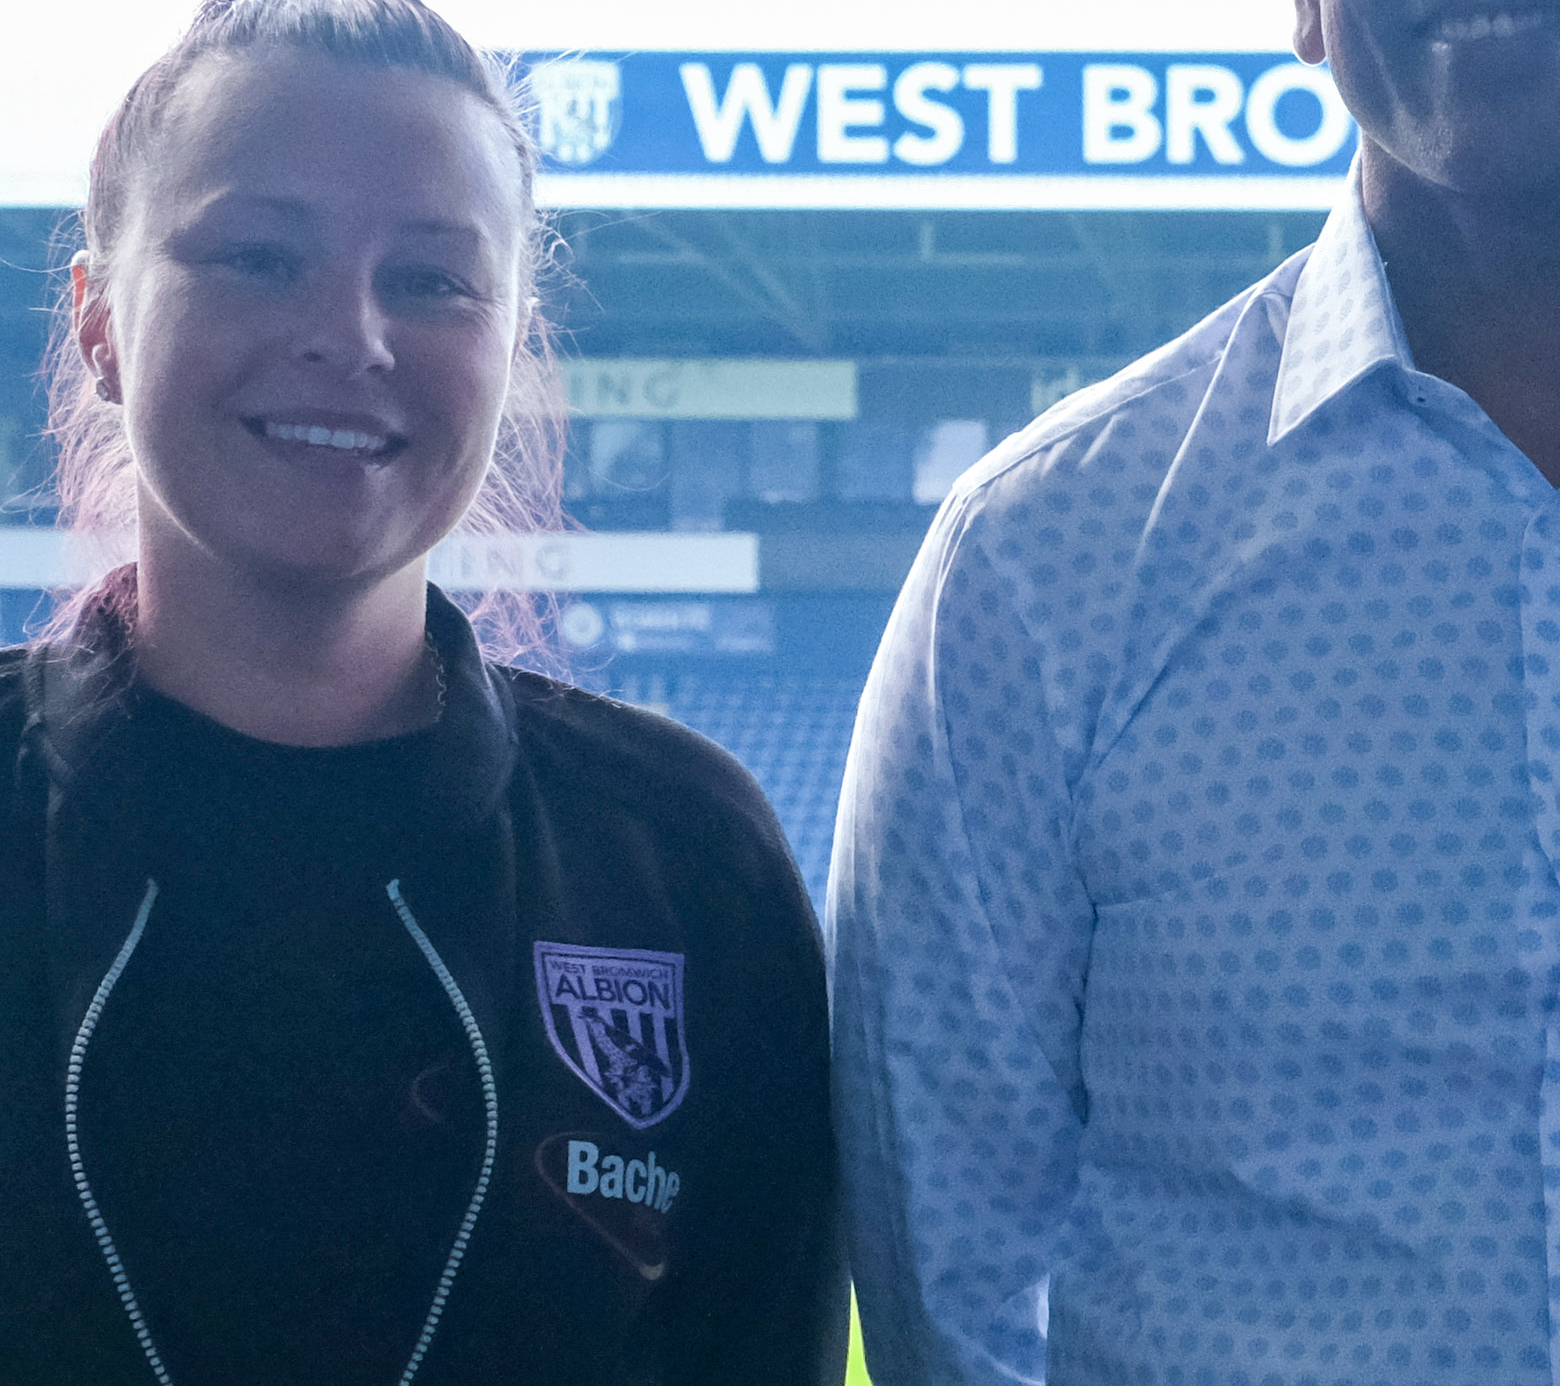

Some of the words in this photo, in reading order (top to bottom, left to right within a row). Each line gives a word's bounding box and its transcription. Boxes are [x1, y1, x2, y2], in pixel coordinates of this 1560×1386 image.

[679, 61, 1042, 166] WEST
[550, 960, 587, 974] WEST
[591, 964, 669, 980] BROMWICH
[555, 973, 671, 1010] ALBION
[566, 1139, 680, 1213] Bache
